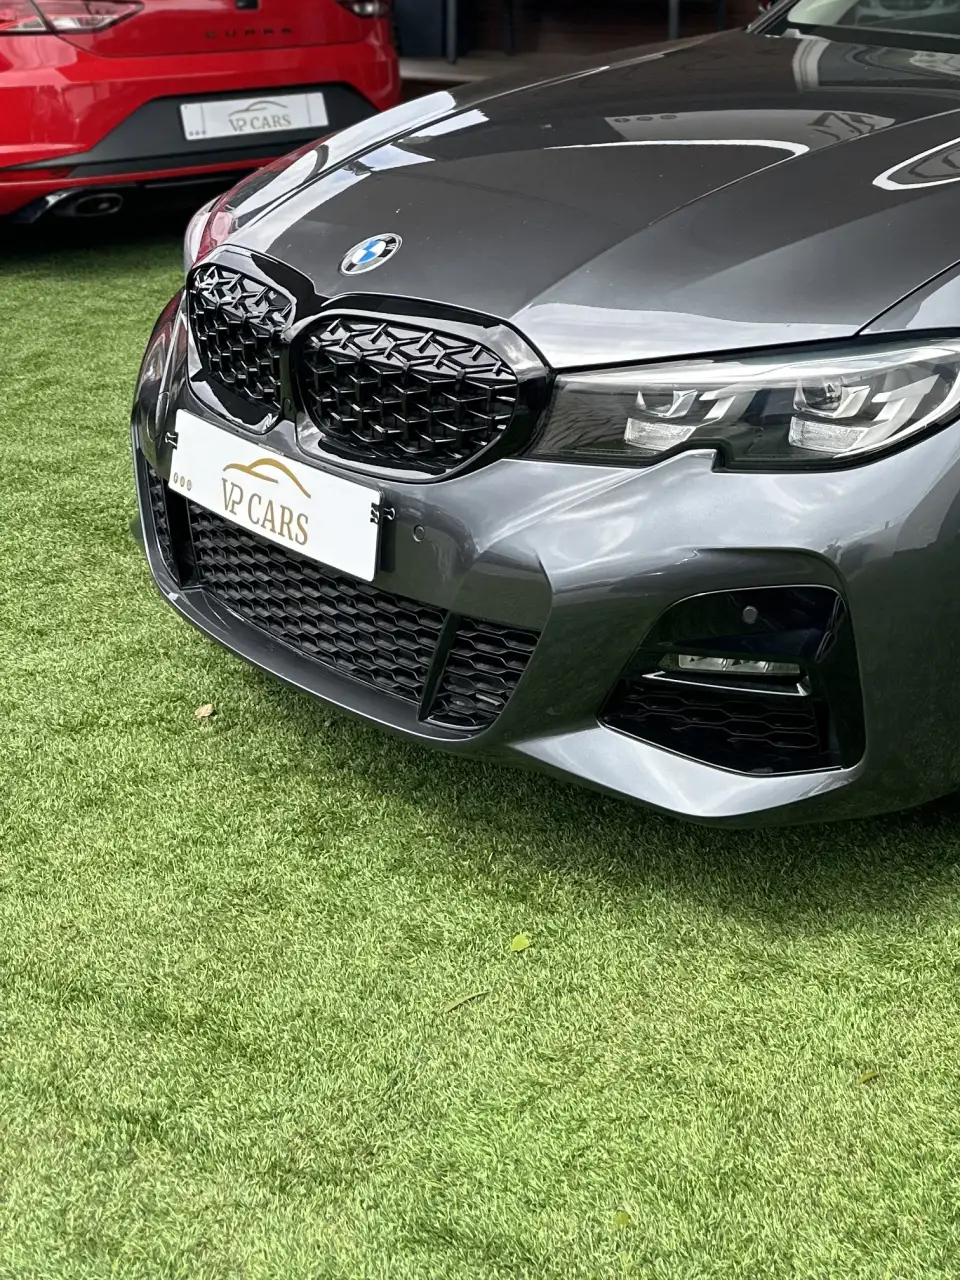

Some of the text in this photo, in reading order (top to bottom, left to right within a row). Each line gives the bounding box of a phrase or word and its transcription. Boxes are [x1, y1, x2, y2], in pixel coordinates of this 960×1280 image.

[228, 114, 292, 132] VP CARS
[221, 477, 309, 546] VP CARS
